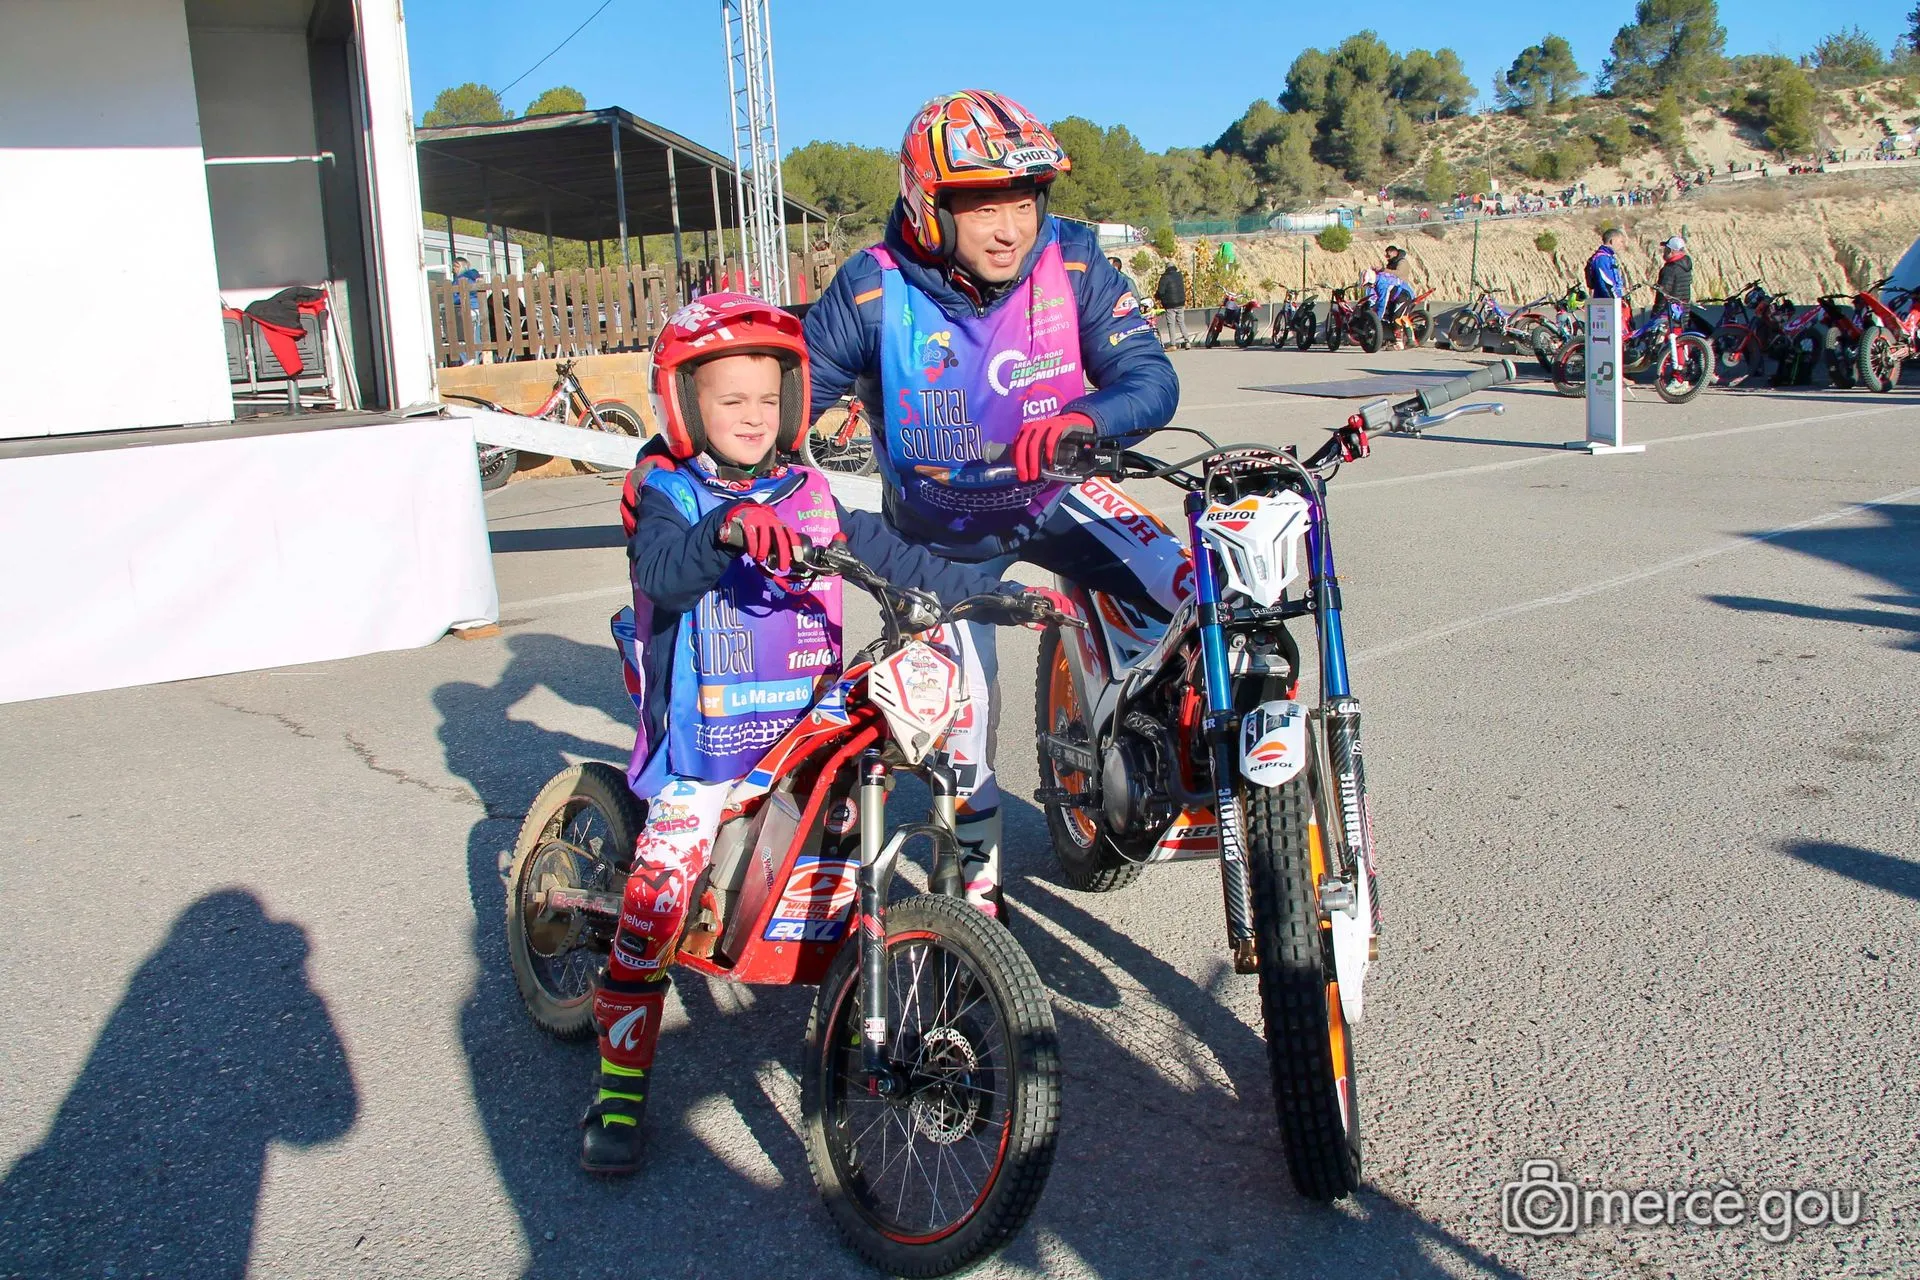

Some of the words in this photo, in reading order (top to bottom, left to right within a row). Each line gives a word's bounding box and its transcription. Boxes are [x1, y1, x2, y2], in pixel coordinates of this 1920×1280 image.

[1011, 149, 1052, 165] SHOEI
[1011, 356, 1063, 380] CIRCUIT
[1012, 360, 1032, 370] AREA
[1008, 362, 1076, 390] PARCMOTOR
[1022, 396, 1058, 417] fcm
[1079, 479, 1160, 547] HOND
[1206, 510, 1257, 522] REPSOL
[796, 609, 828, 630] fcm
[731, 692, 747, 707] La
[749, 685, 809, 704] Marató
[1249, 761, 1294, 772] REPSOL
[1175, 825, 1219, 838] REP
[623, 911, 654, 932] velvet
[769, 920, 838, 941] 20XL
